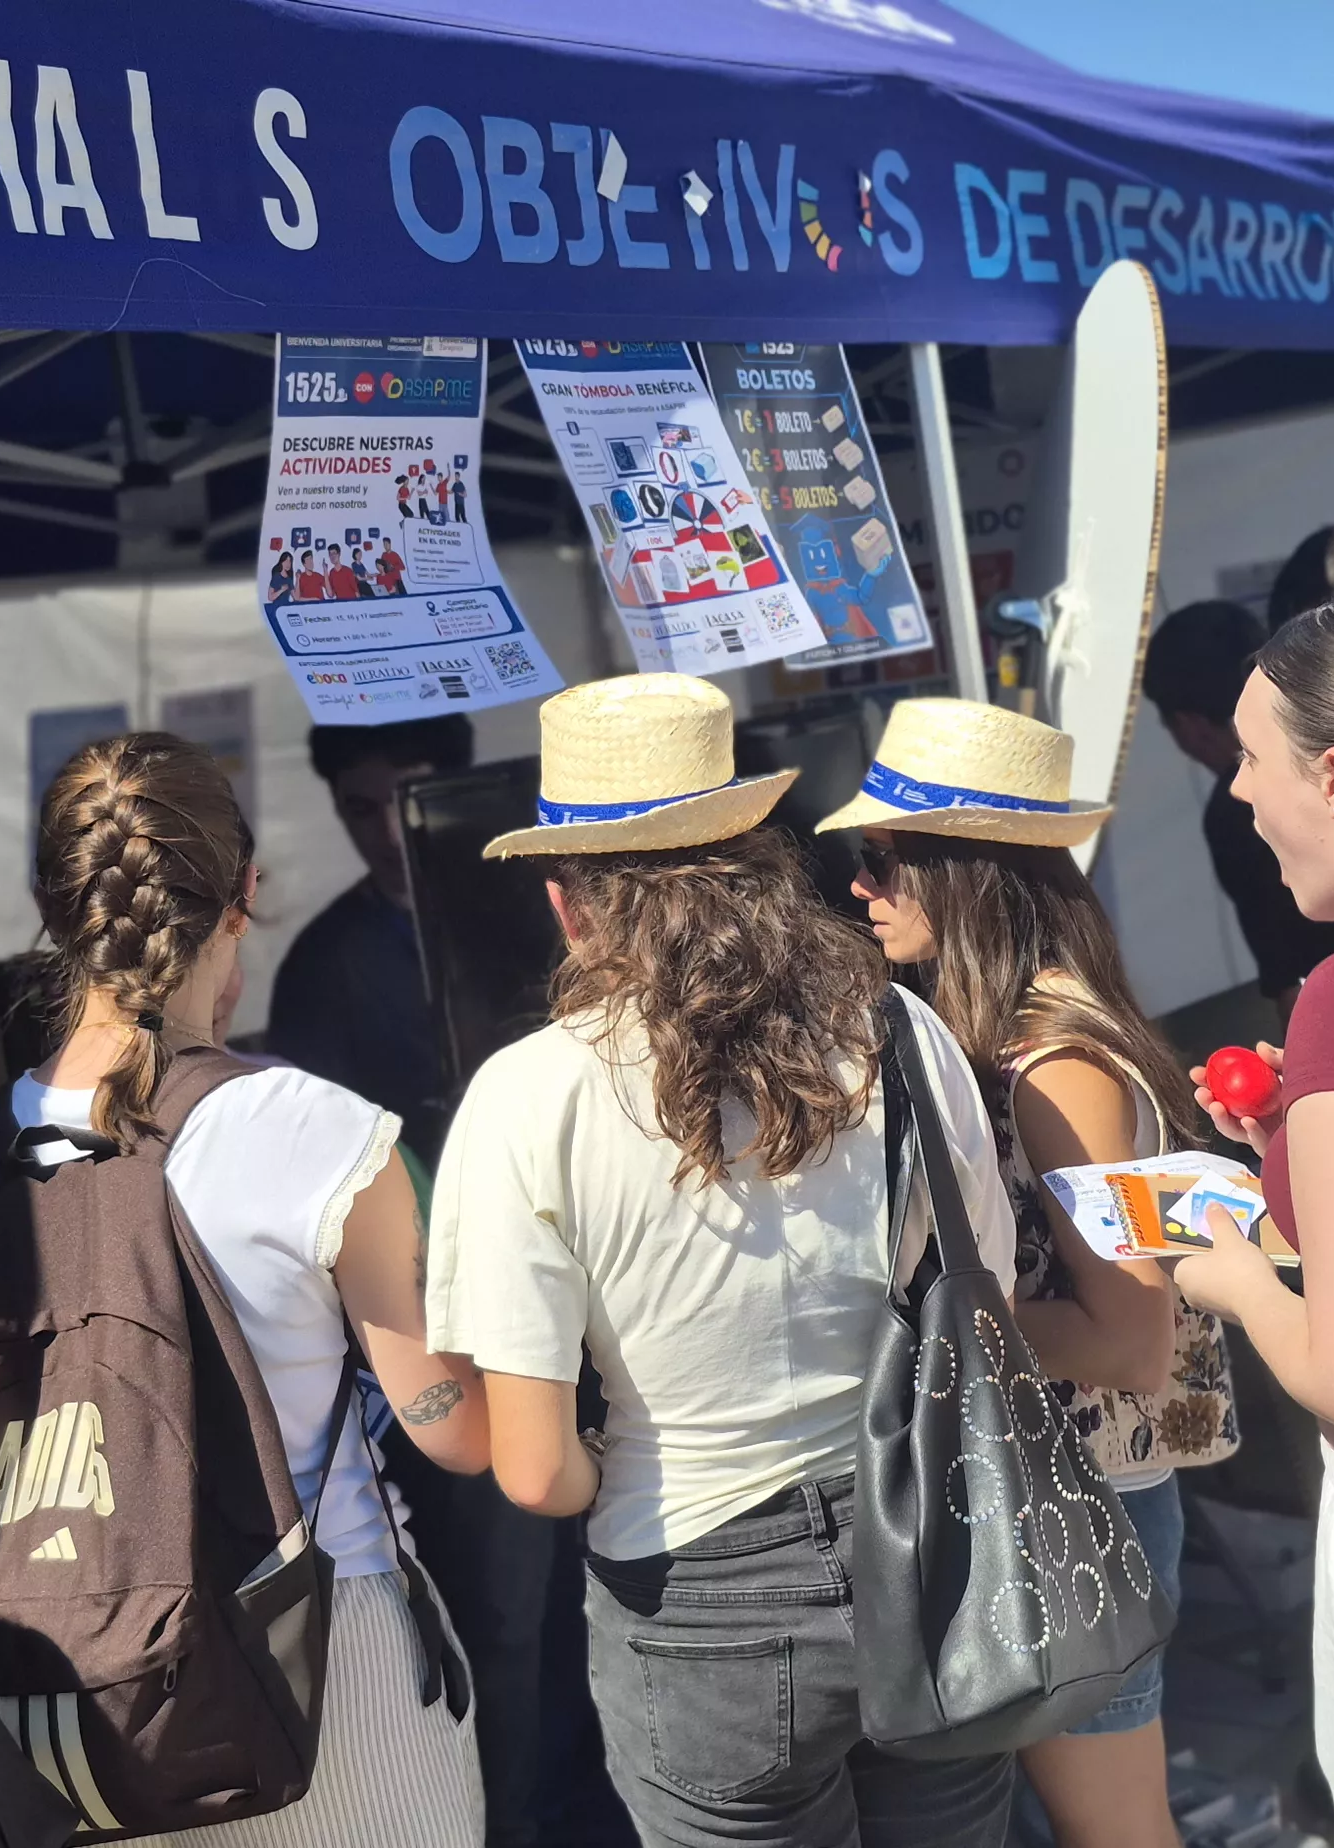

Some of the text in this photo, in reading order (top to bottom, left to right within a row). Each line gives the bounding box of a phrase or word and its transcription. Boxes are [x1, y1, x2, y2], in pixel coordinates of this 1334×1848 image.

[389, 105, 924, 277] OBJEIVS
[953, 162, 1060, 284] DE
[286, 336, 330, 347] BIENVENIDA
[331, 338, 383, 349] UNIVERSITARIA
[285, 371, 337, 404] 1525
[355, 383, 373, 393] CON
[541, 379, 697, 399] GRAN TÓMBOLA BENÉFICA
[735, 368, 816, 391] BOLETOS
[734, 409, 756, 434] 1€
[774, 411, 813, 433] BOLETO
[282, 436, 434, 453] DESCUBRE NUESTRAS
[280, 456, 392, 477] ACTIVIDADES
[742, 448, 765, 473] 2€
[770, 448, 784, 472] 3
[783, 448, 828, 471] BOLETOS
[278, 484, 368, 496] Ven a nuestro stand y
[792, 485, 838, 509] BOLETOS
[275, 500, 368, 512] conecta con nosotros
[306, 658, 472, 684] eboca HERALDO LACASA
